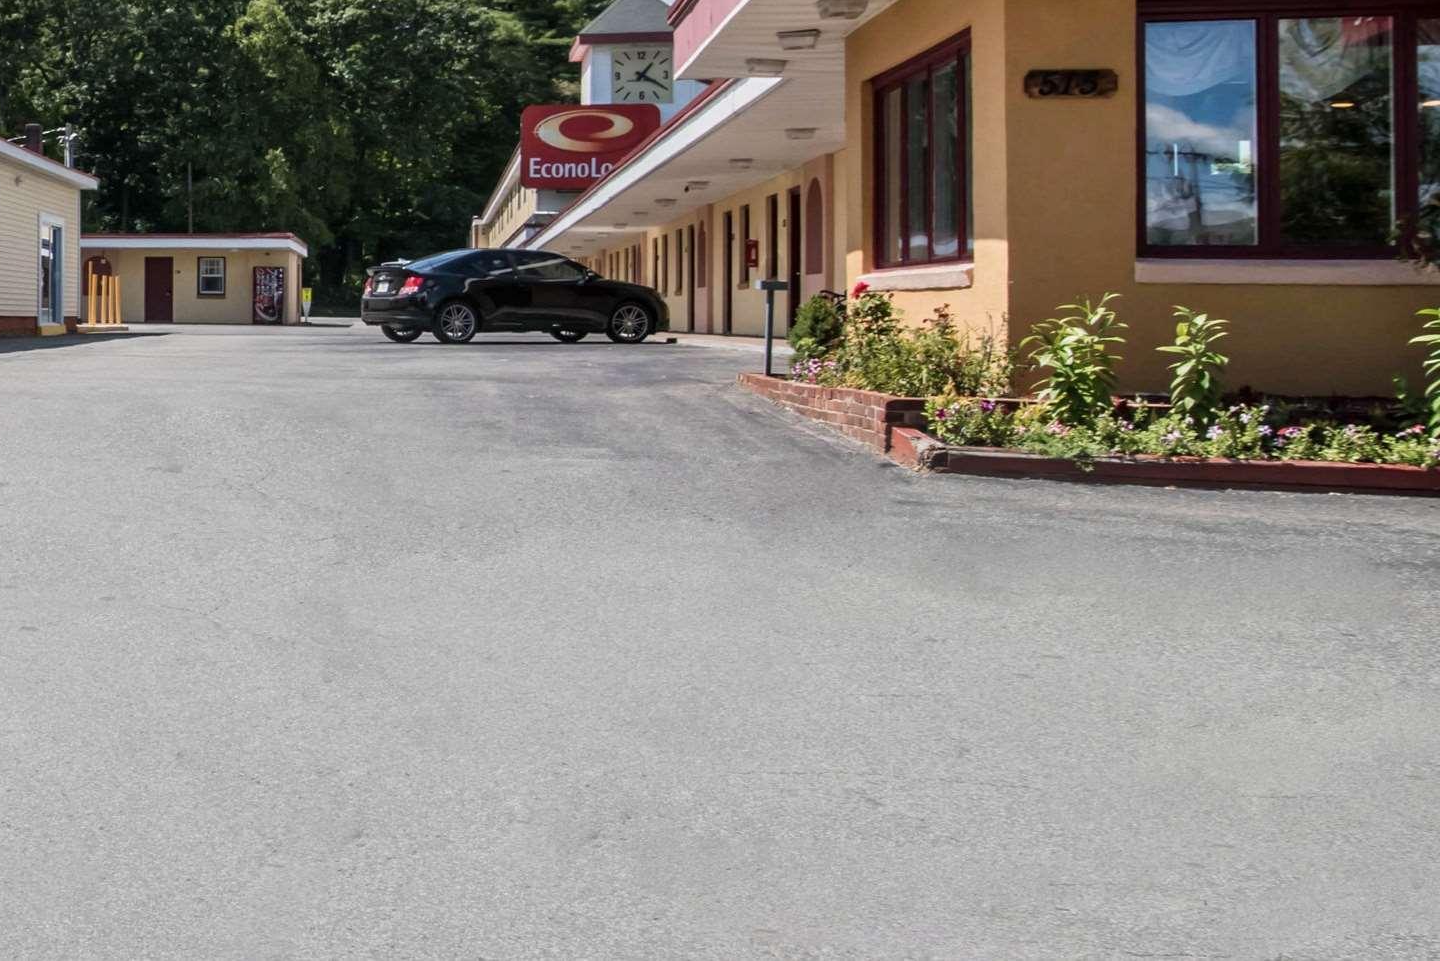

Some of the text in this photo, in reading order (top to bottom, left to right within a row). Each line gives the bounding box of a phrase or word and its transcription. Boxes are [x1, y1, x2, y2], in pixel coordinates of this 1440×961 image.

[637, 51, 646, 60] 12
[639, 91, 645, 100] 6
[529, 157, 613, 178] EconoLo
